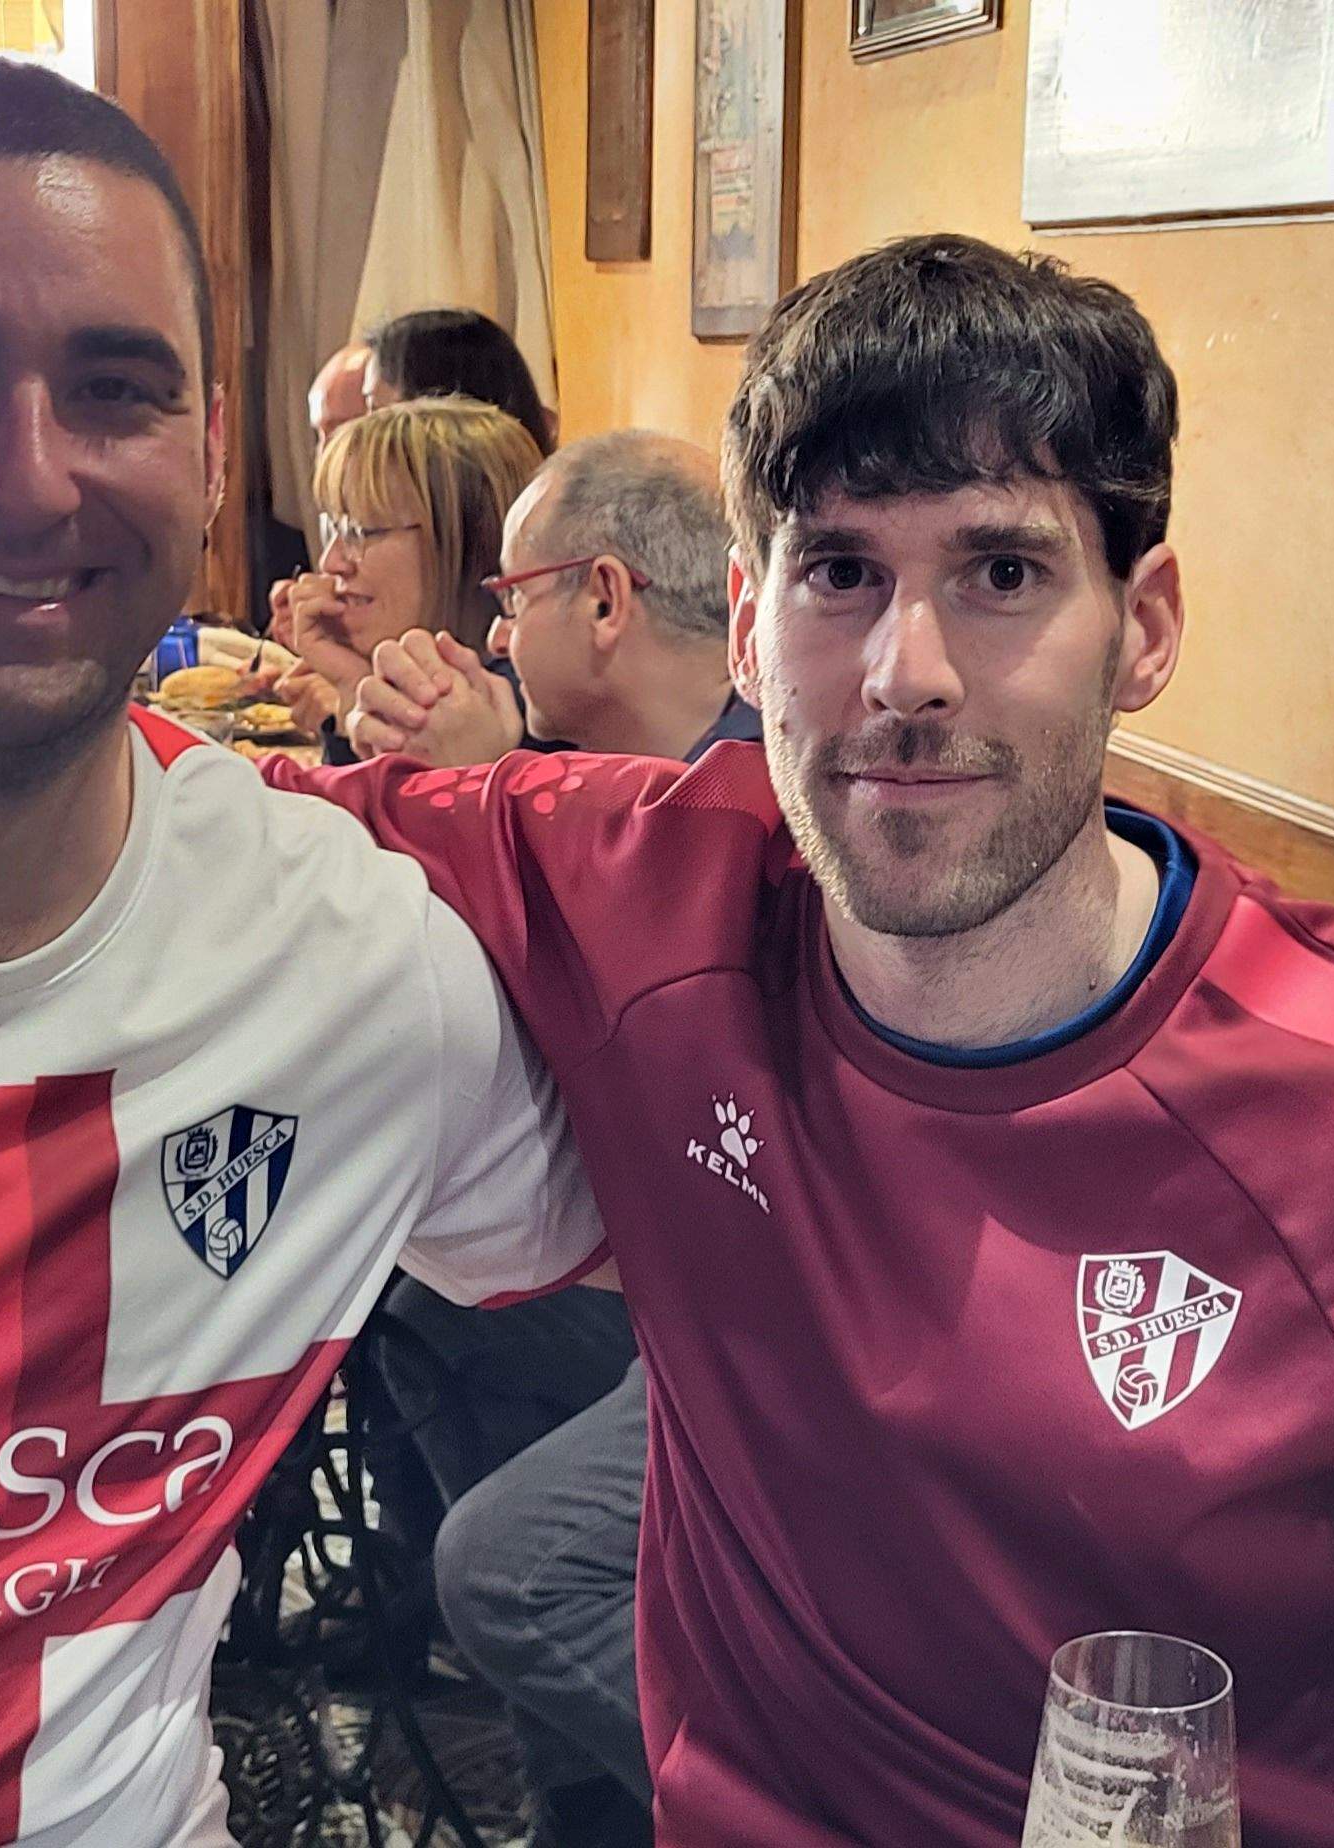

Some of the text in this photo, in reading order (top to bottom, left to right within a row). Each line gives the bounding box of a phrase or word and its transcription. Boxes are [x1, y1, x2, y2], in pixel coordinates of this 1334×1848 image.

[183, 1127, 288, 1221] S.D. HUESCA
[1095, 1297, 1229, 1356] S.D. HUESCA
